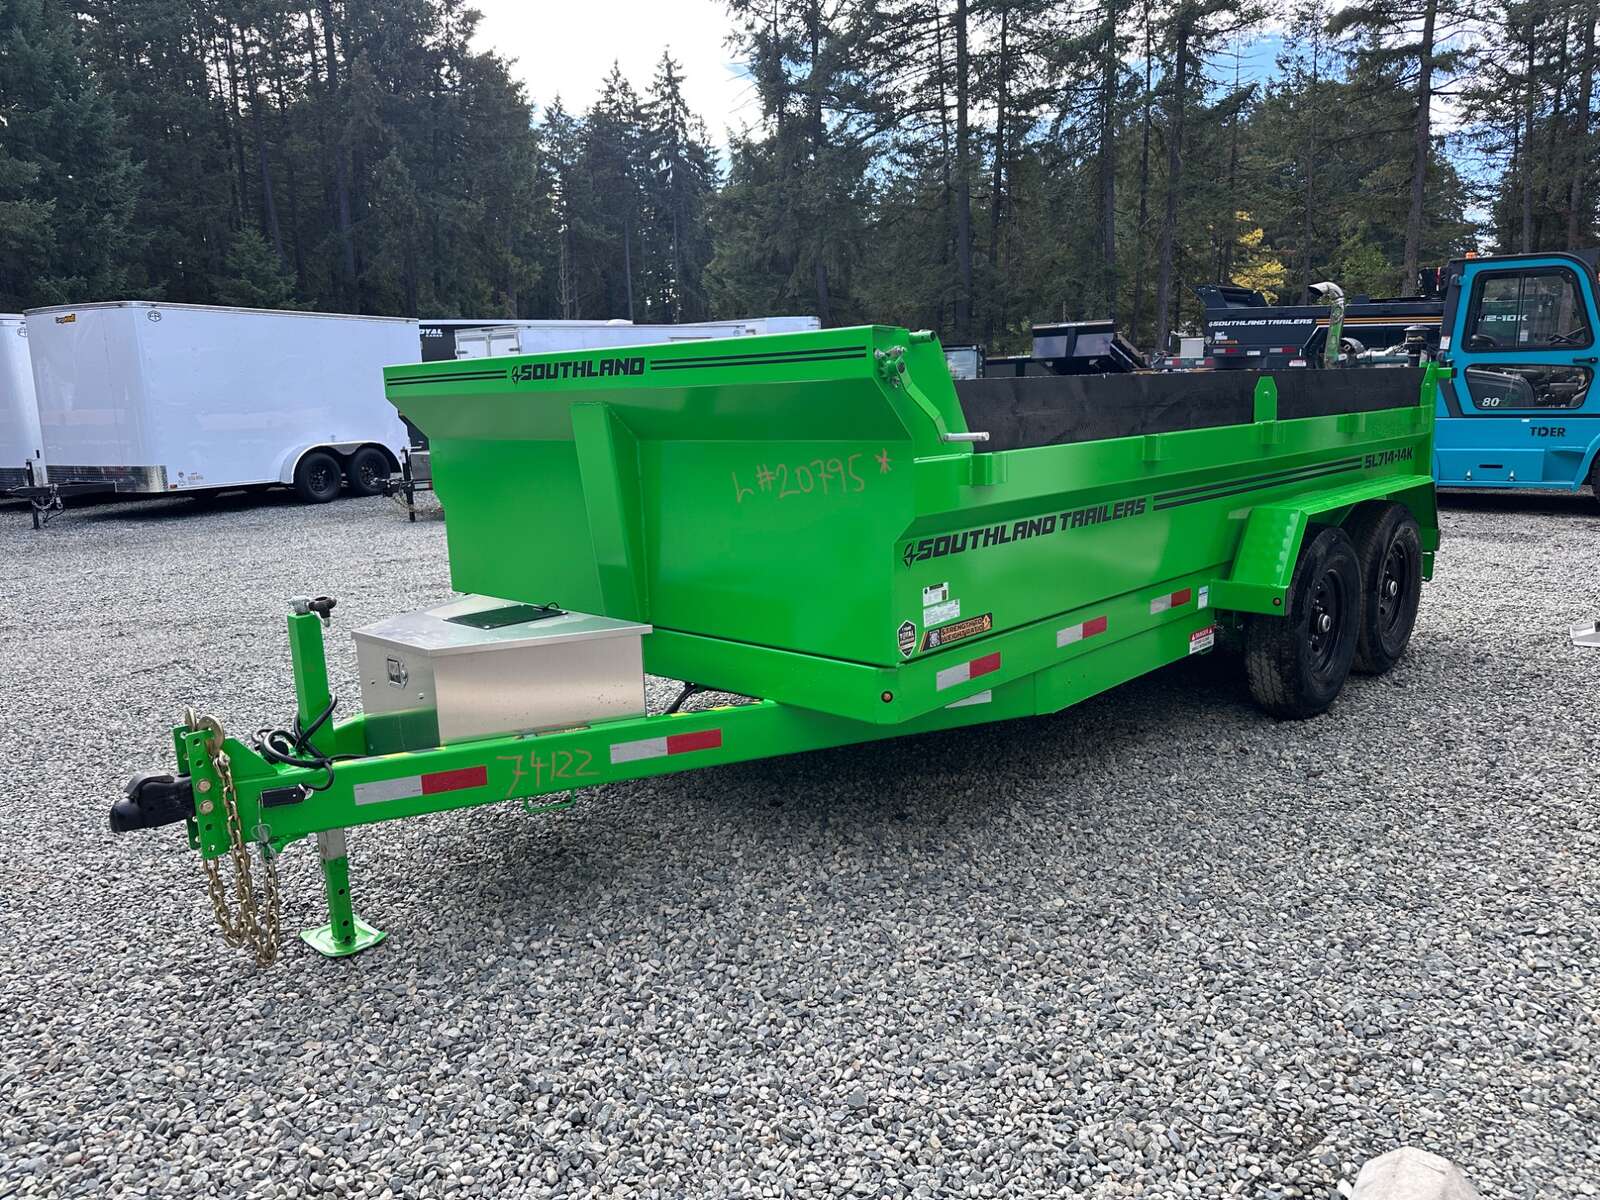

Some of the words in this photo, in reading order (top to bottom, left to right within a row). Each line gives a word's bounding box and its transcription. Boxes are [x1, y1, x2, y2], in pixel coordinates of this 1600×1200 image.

[1213, 319, 1267, 327] SOUTHLAND
[520, 357, 645, 381] SOUTHLAND
[1482, 398, 1500, 407] 80
[916, 515, 1056, 561] SOUTHLAND
[1060, 497, 1147, 531] TRAILERS
[496, 748, 600, 799] 74122
